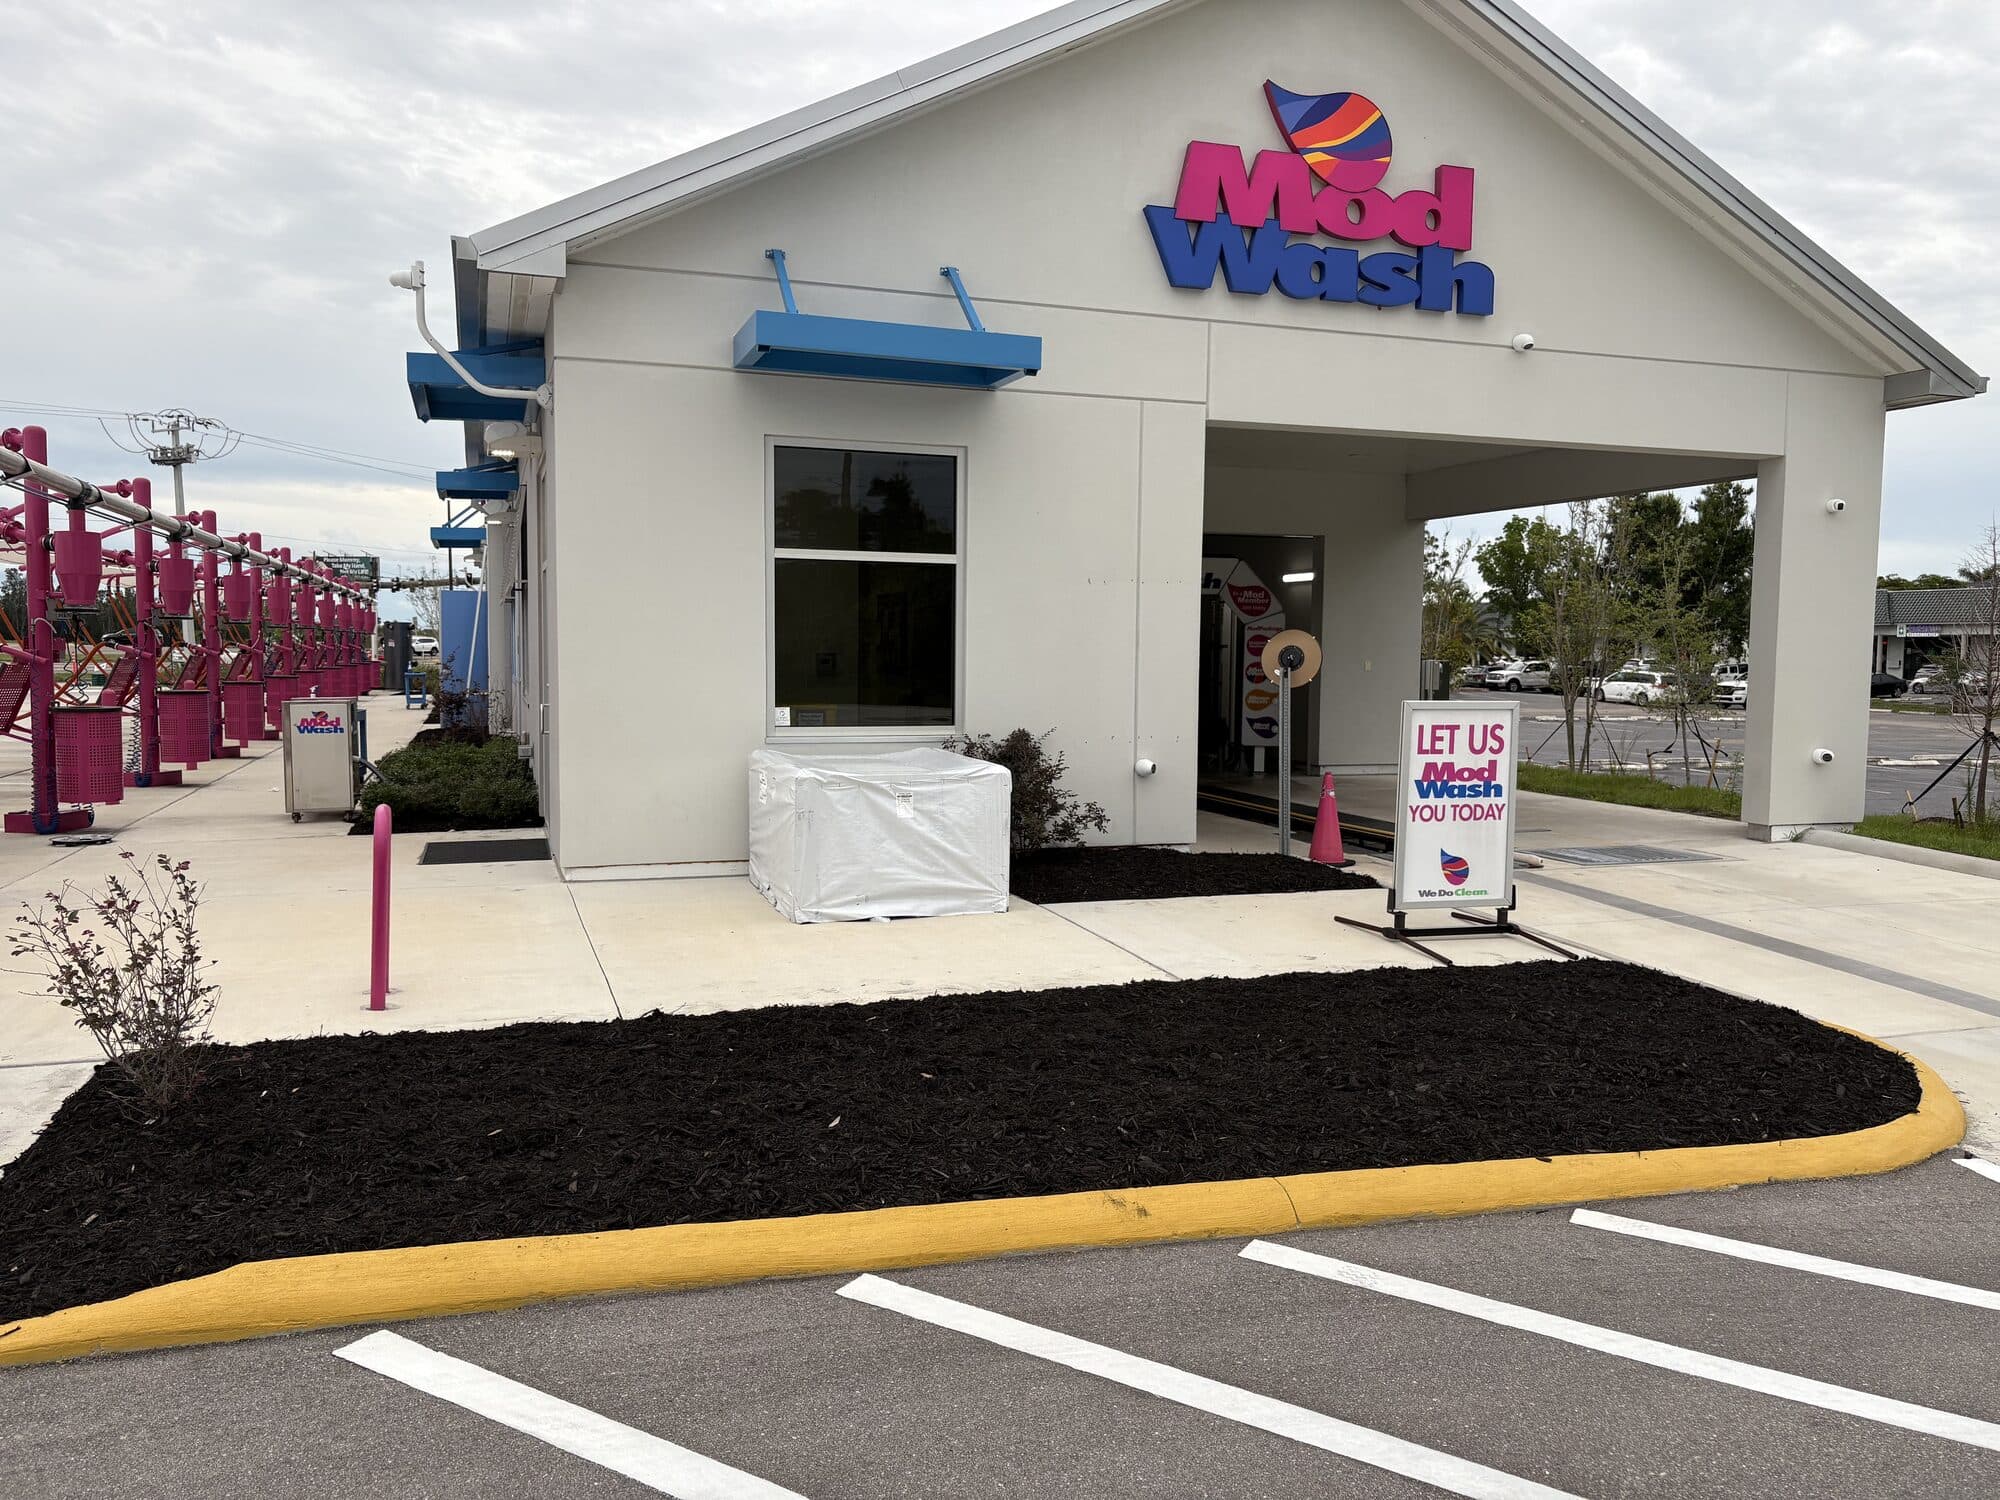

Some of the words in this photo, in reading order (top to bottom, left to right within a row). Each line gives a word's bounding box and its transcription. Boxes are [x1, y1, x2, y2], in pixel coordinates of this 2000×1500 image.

[1174, 140, 1475, 251] Mod
[1143, 205, 1495, 316] Wash
[297, 725, 344, 734] Wash
[300, 717, 341, 726] Mod
[1417, 724, 1460, 755] LET
[1468, 723, 1505, 755] US
[1421, 760, 1498, 782] Mod
[1414, 780, 1503, 799] Wash
[1409, 804, 1446, 823] YOU
[1450, 803, 1506, 822] TODAY
[1418, 889, 1437, 898] We
[1438, 889, 1454, 897] Do
[1454, 888, 1488, 897] Clean
